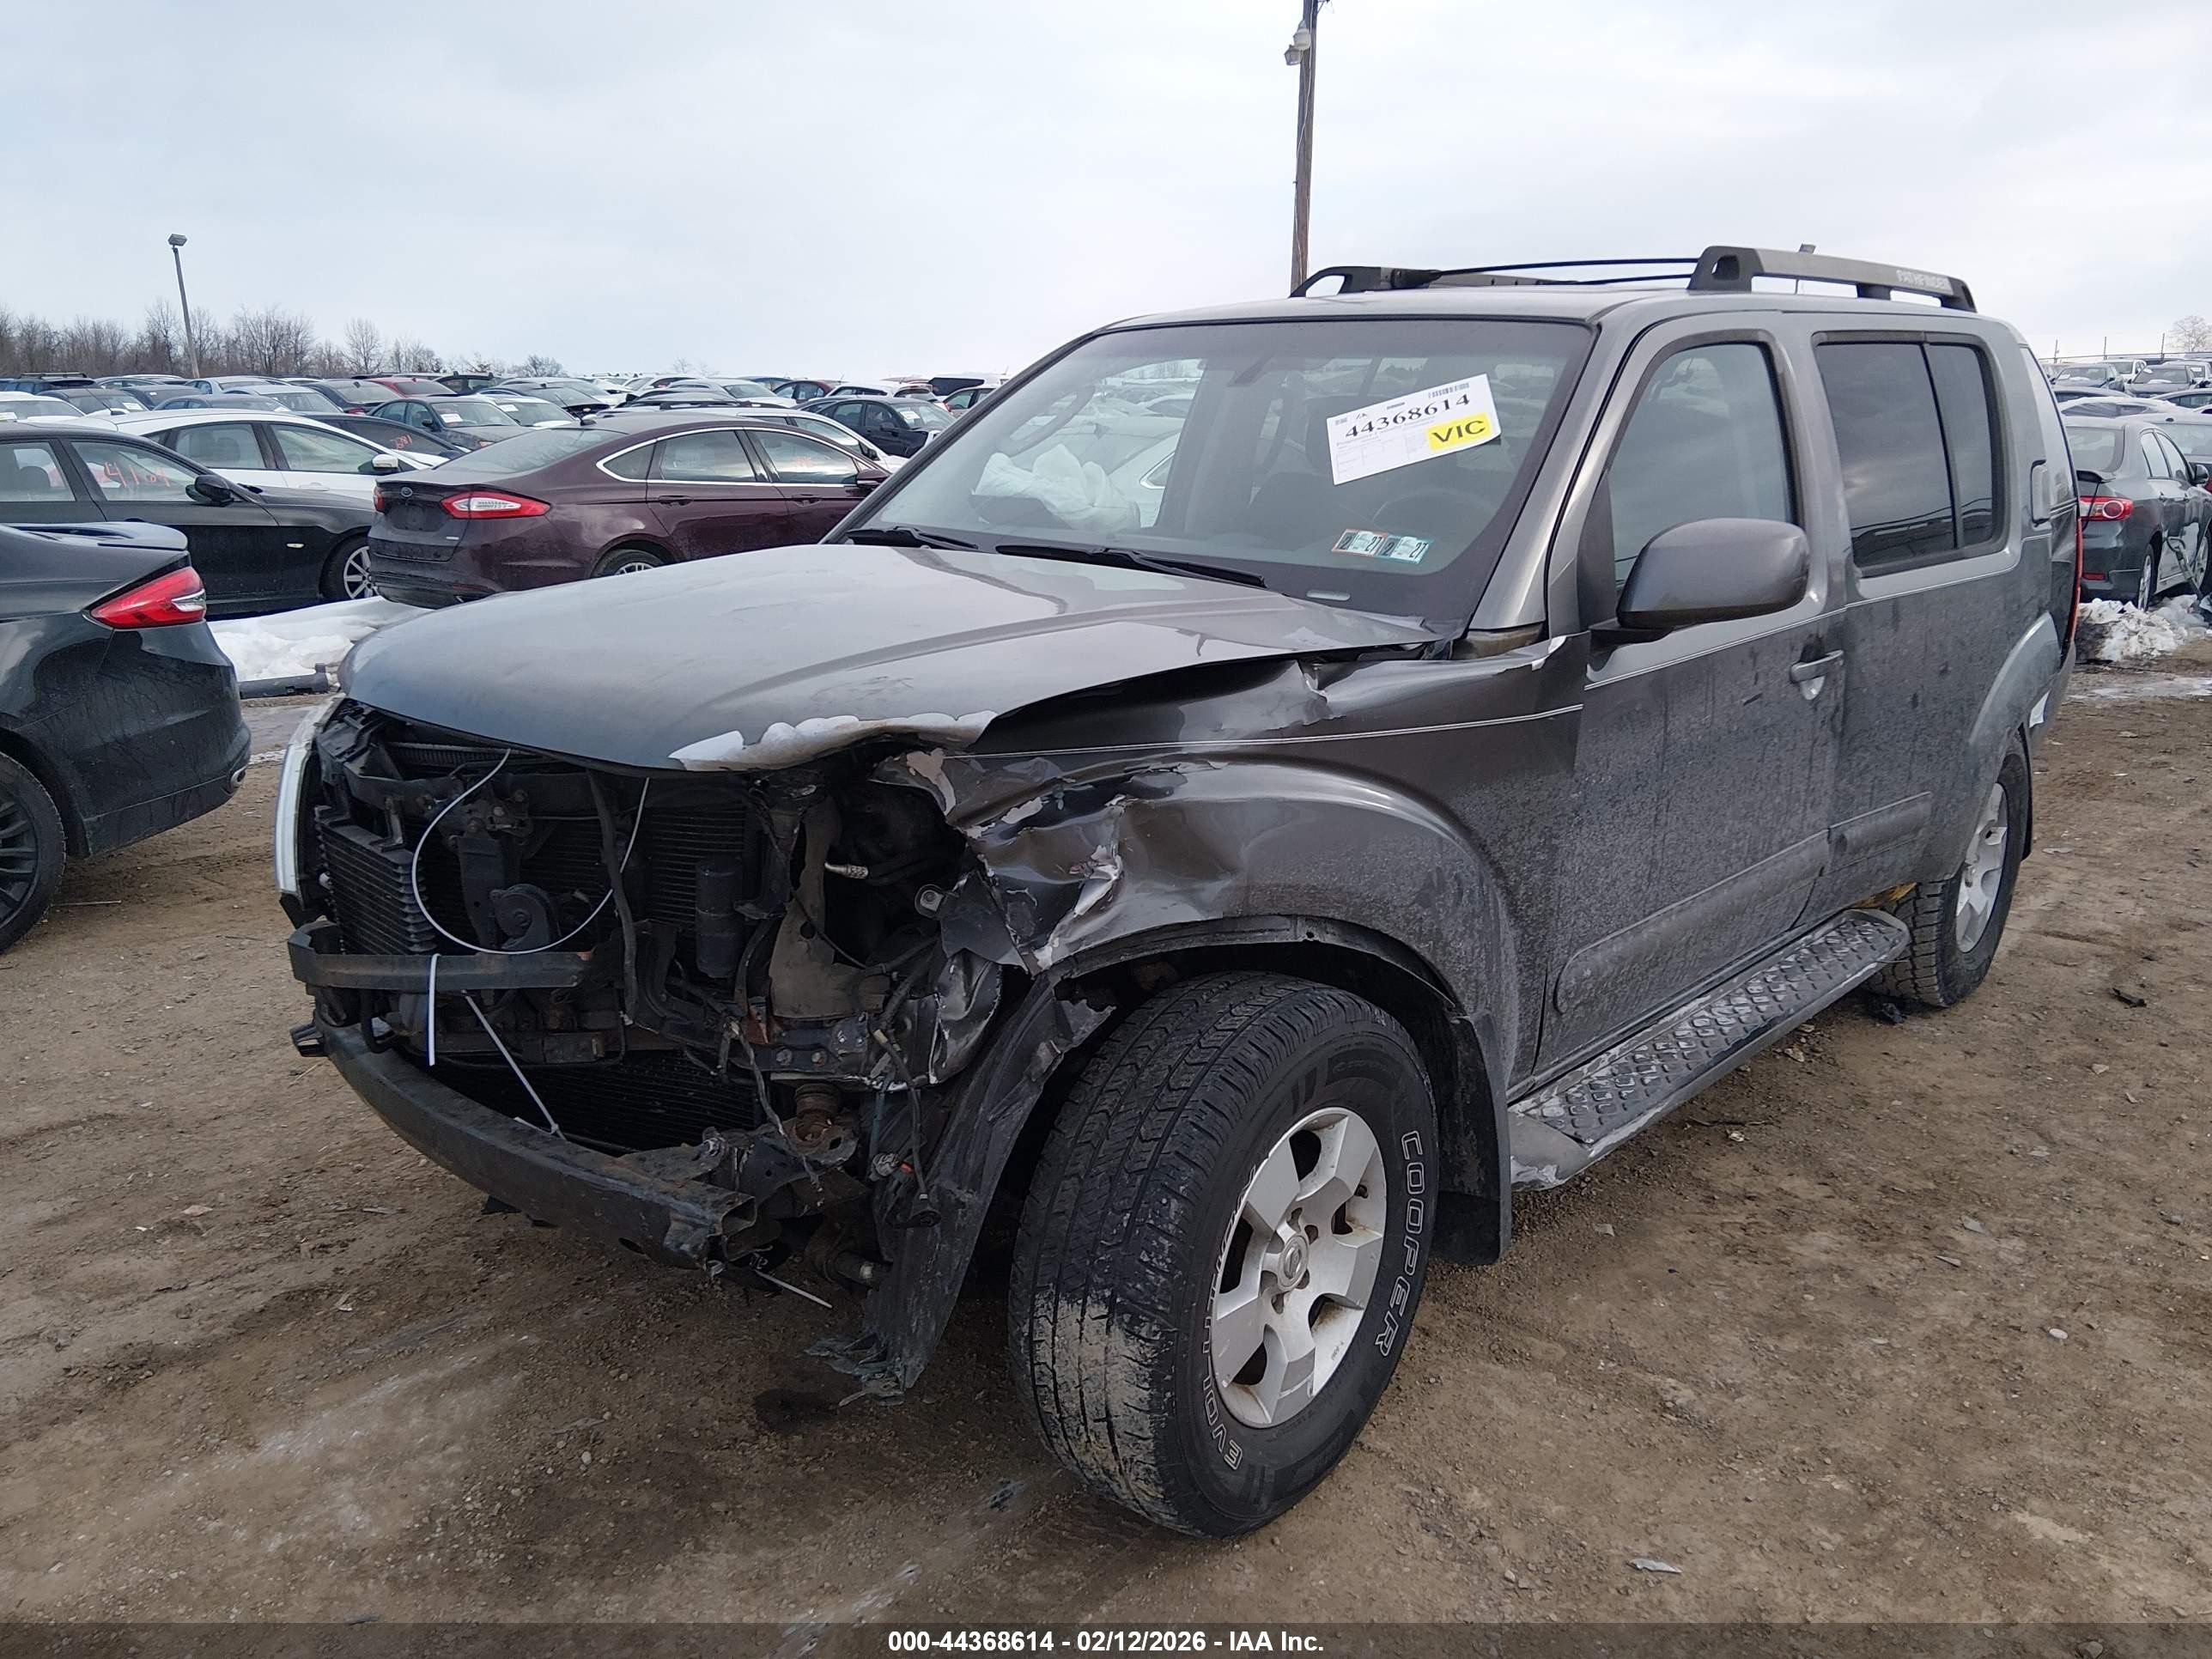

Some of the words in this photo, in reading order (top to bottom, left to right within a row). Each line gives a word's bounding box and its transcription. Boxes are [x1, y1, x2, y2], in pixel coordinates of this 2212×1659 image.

[1345, 393, 1470, 438] 44368614
[1431, 419, 1486, 443] VIC
[1340, 536, 1352, 550] 2
[1364, 536, 1382, 553] 27
[1382, 541, 1395, 556] 2
[1408, 542, 1427, 559] 27
[1375, 1130, 1425, 1357] COOPER
